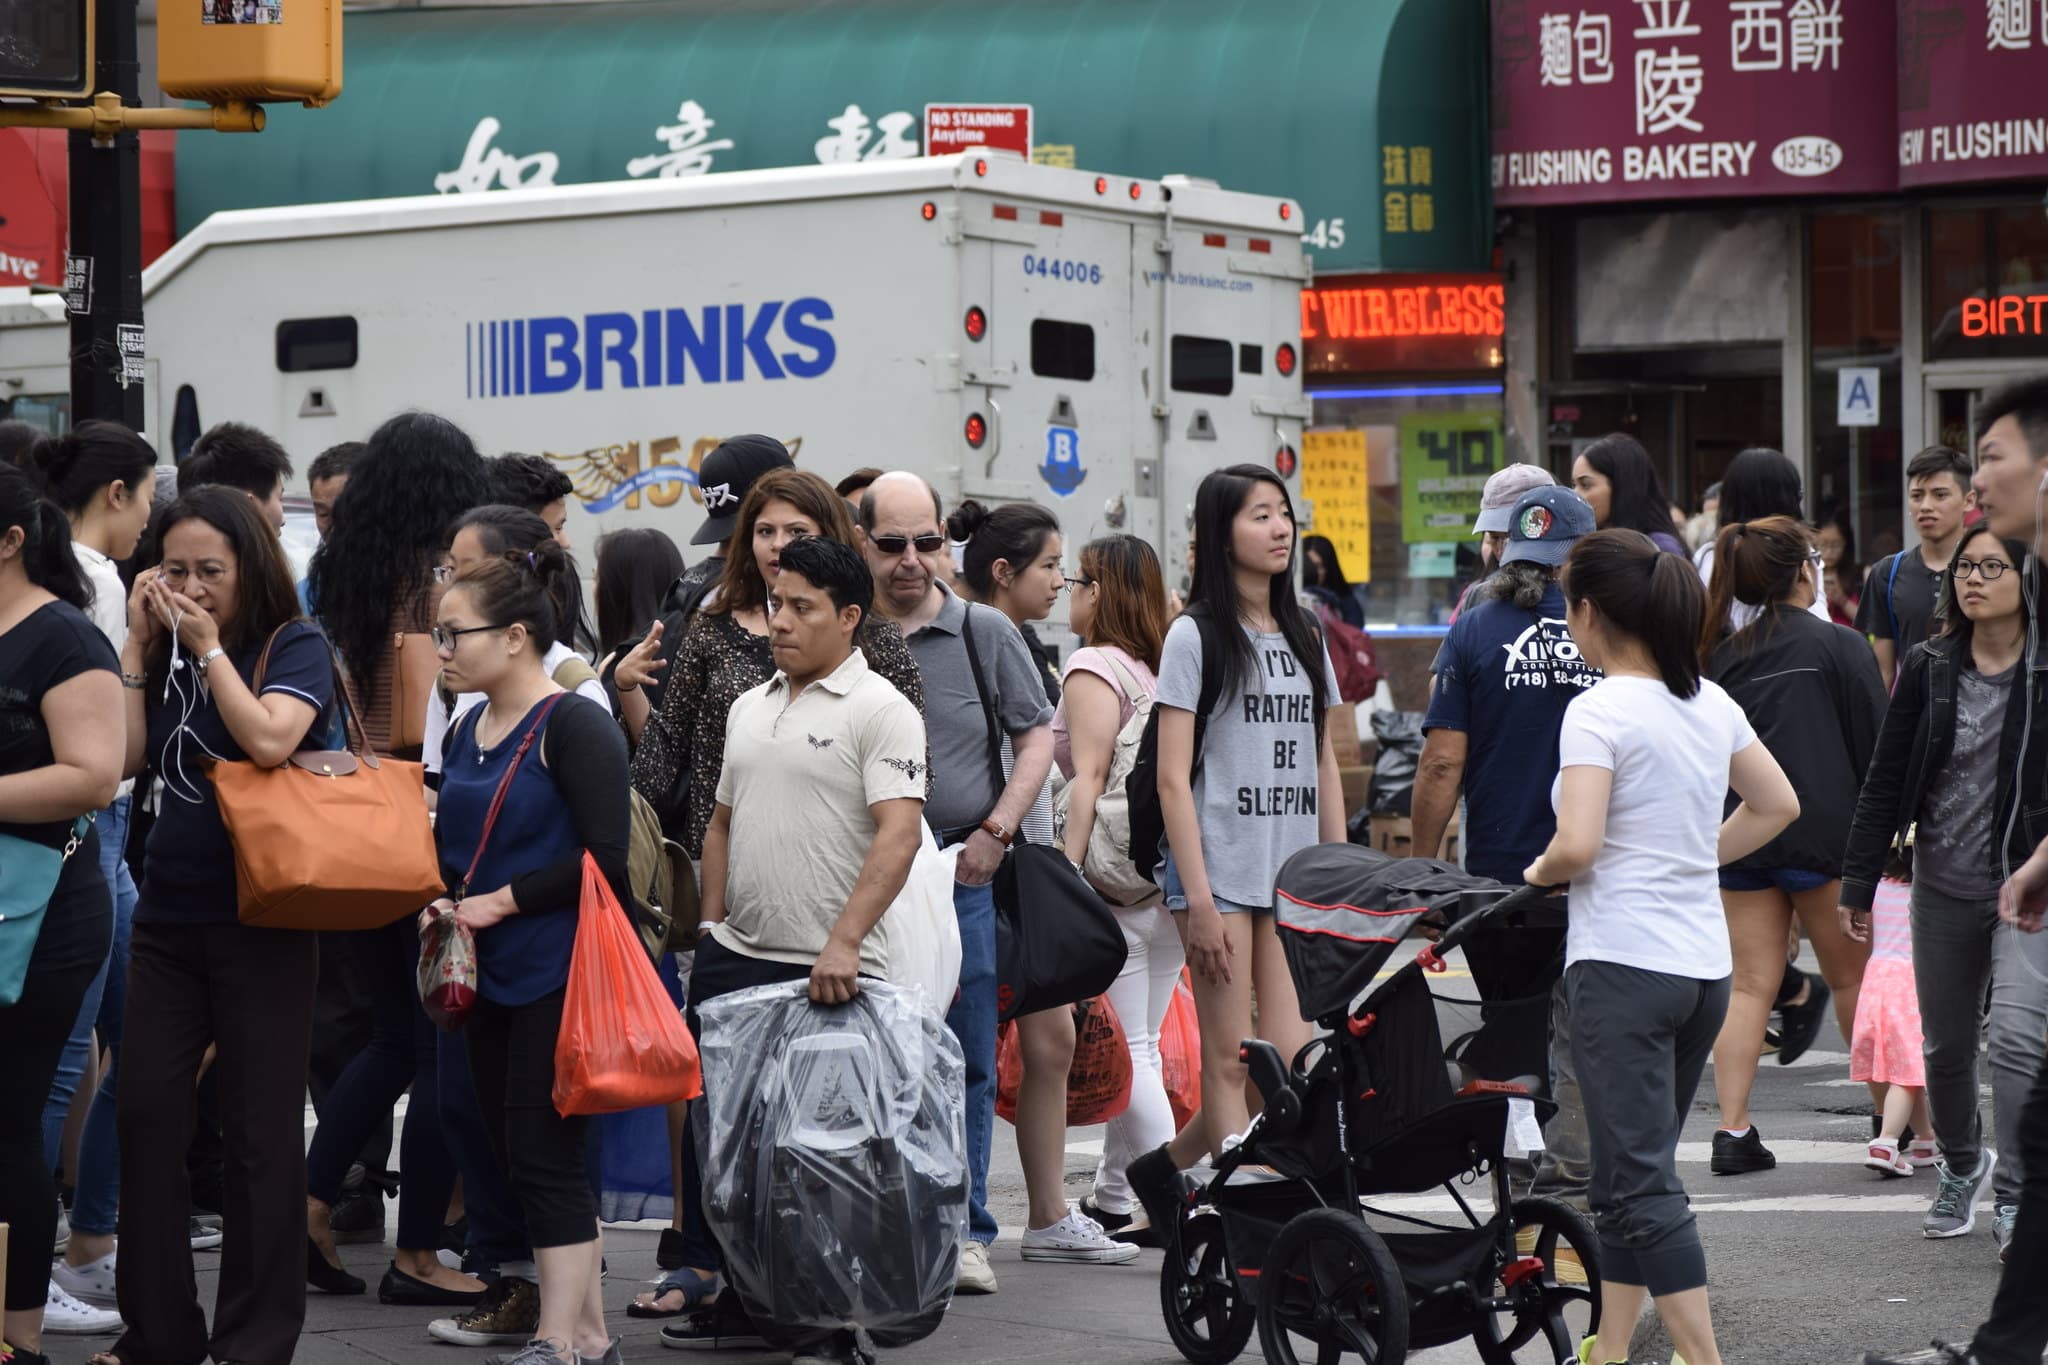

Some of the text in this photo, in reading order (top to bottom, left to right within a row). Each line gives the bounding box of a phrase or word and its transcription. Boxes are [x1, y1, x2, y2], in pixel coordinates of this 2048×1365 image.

[1729, 0, 1844, 73] 西餅
[1986, 0, 2048, 51] 麵
[1539, 10, 1614, 87] 麵包
[931, 111, 1015, 128] NO STANDING
[931, 128, 985, 144] Anytime
[1900, 117, 2048, 166] EW FLUSHIN
[1509, 147, 1612, 187] FLUSHING
[1623, 140, 1757, 182] BAKERY
[1780, 143, 1834, 169] 135-45
[1023, 254, 1101, 285] 044006
[1320, 283, 1505, 338] WIRELESS
[1962, 295, 2048, 337] BIRT
[528, 296, 837, 395] BRINKS
[1846, 375, 1871, 410] A
[1055, 433, 1072, 463] B
[1265, 650, 1297, 678] I'D
[1505, 671, 1548, 690] (718)
[1243, 694, 1315, 723] RATHE
[1273, 740, 1297, 769] BE
